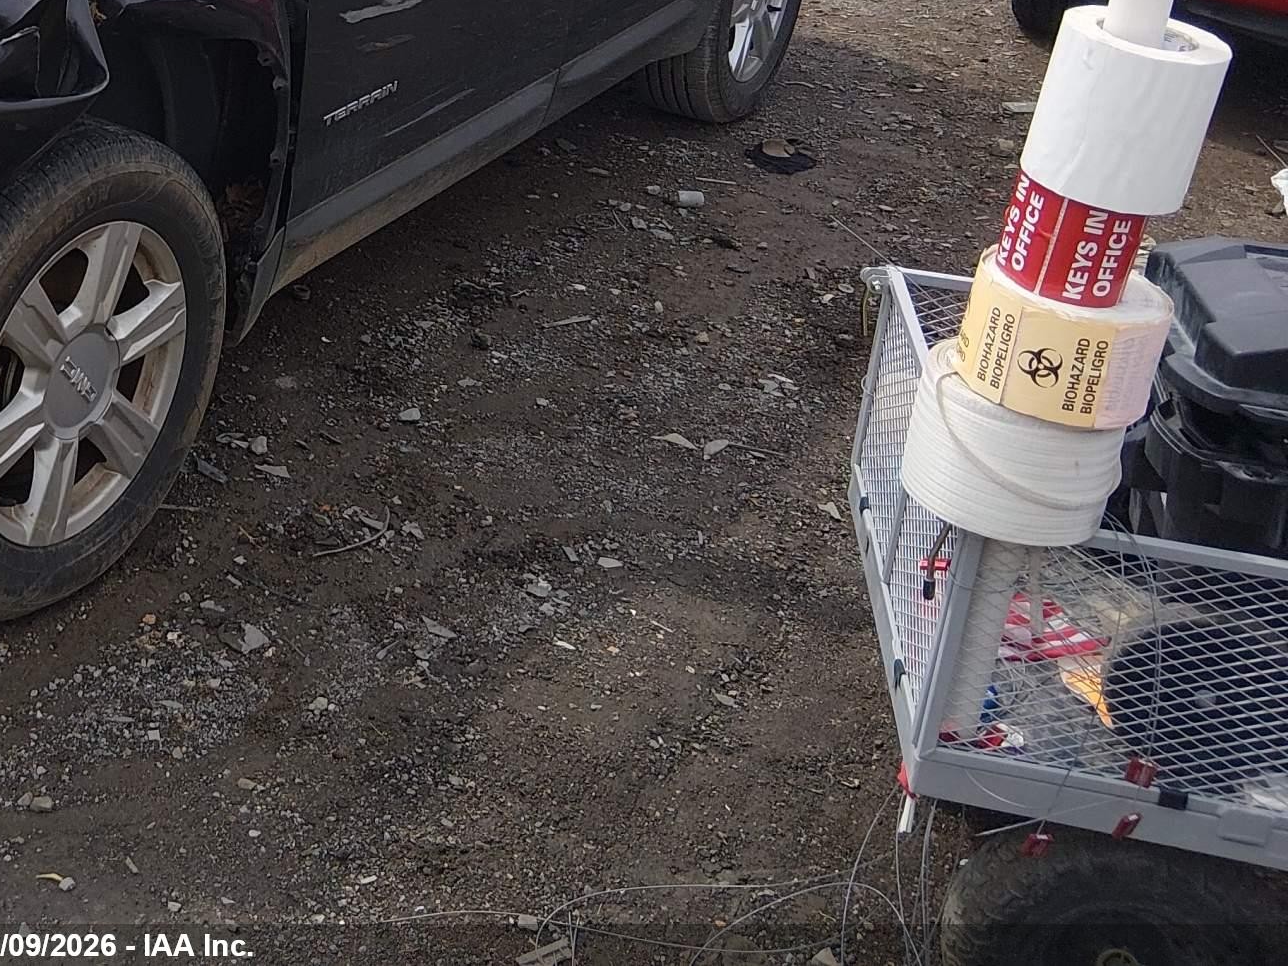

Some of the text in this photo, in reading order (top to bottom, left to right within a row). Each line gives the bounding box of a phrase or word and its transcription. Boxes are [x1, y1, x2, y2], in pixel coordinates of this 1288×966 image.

[322, 80, 400, 127] TERRAIN
[996, 175, 1031, 267] KEYS IN
[1011, 191, 1045, 272] OFFICE
[1062, 209, 1109, 300] KEYS IN
[1092, 220, 1132, 297] OFFICE
[977, 306, 1001, 382] BIOHAZARD
[990, 313, 1016, 390] BIOPELIGRO
[1061, 337, 1091, 412] BIOHAZARD
[1080, 340, 1109, 415] BIOPELIGRO
